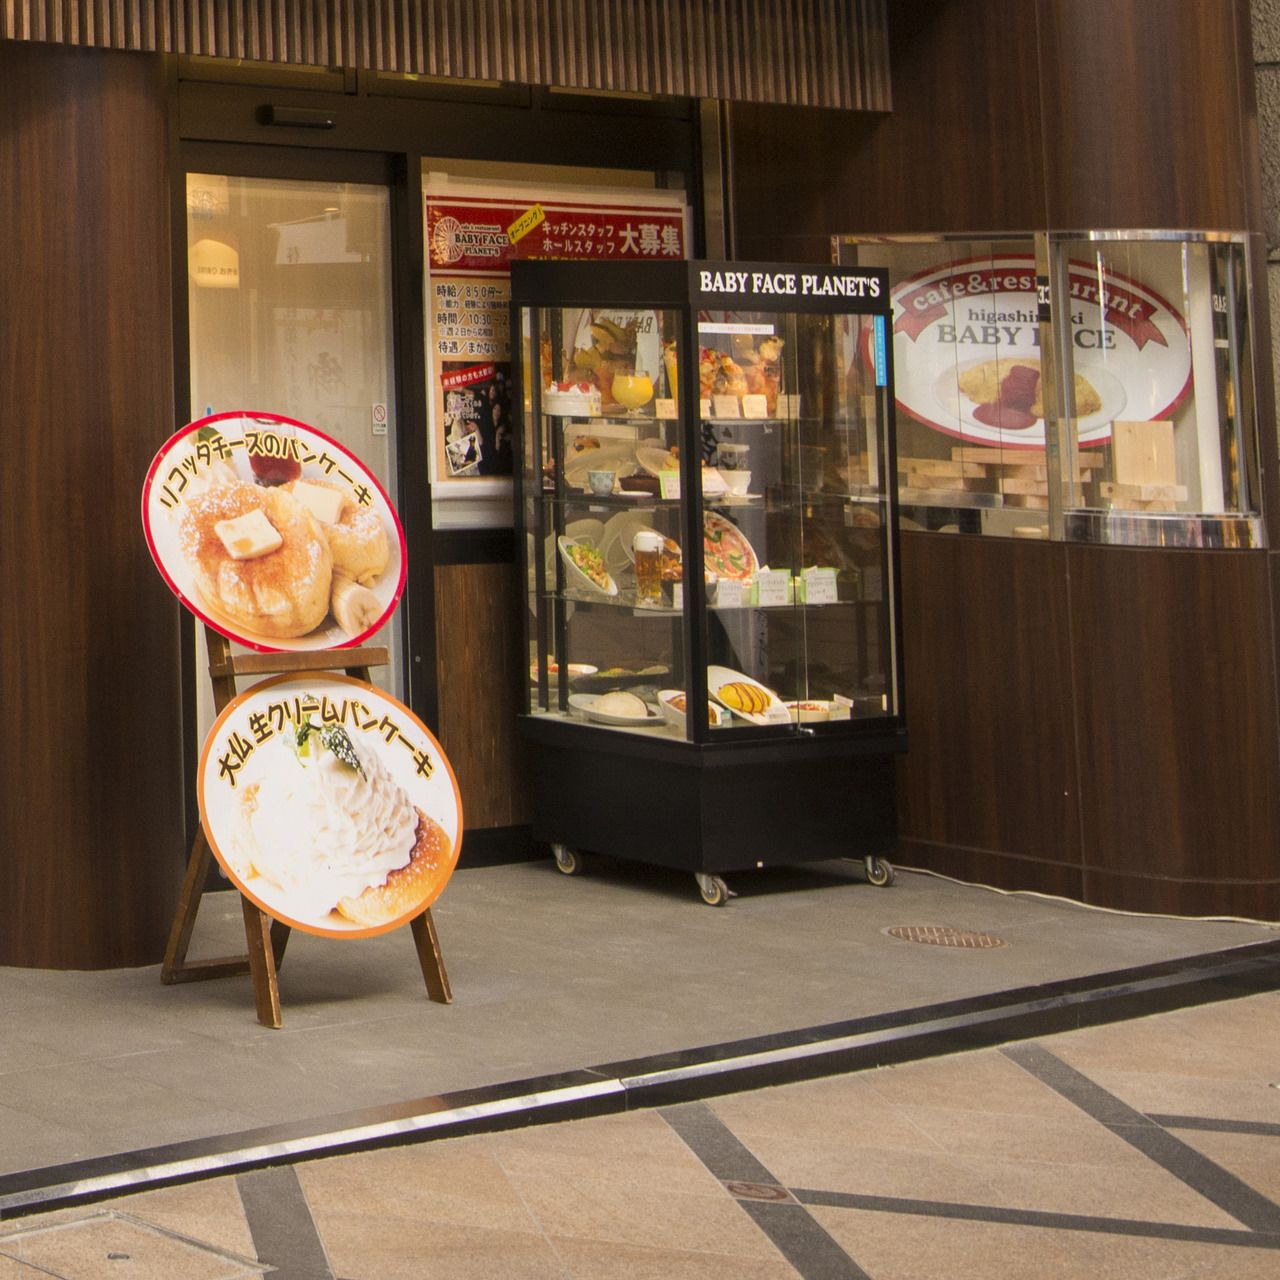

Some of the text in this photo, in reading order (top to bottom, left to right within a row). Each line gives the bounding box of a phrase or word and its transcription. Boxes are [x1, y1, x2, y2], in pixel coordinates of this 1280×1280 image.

[542, 221, 614, 238] キッチンスタッフ
[454, 233, 508, 246] BABY FACE
[543, 238, 615, 254] ホールスタッフ
[619, 223, 680, 256] 大募集
[464, 246, 499, 256] PLANET'S
[700, 271, 880, 298] BABY FACE PLANET'S
[938, 324, 1020, 346] BABY
[159, 432, 372, 508] リコッタチーズのパンケーキ
